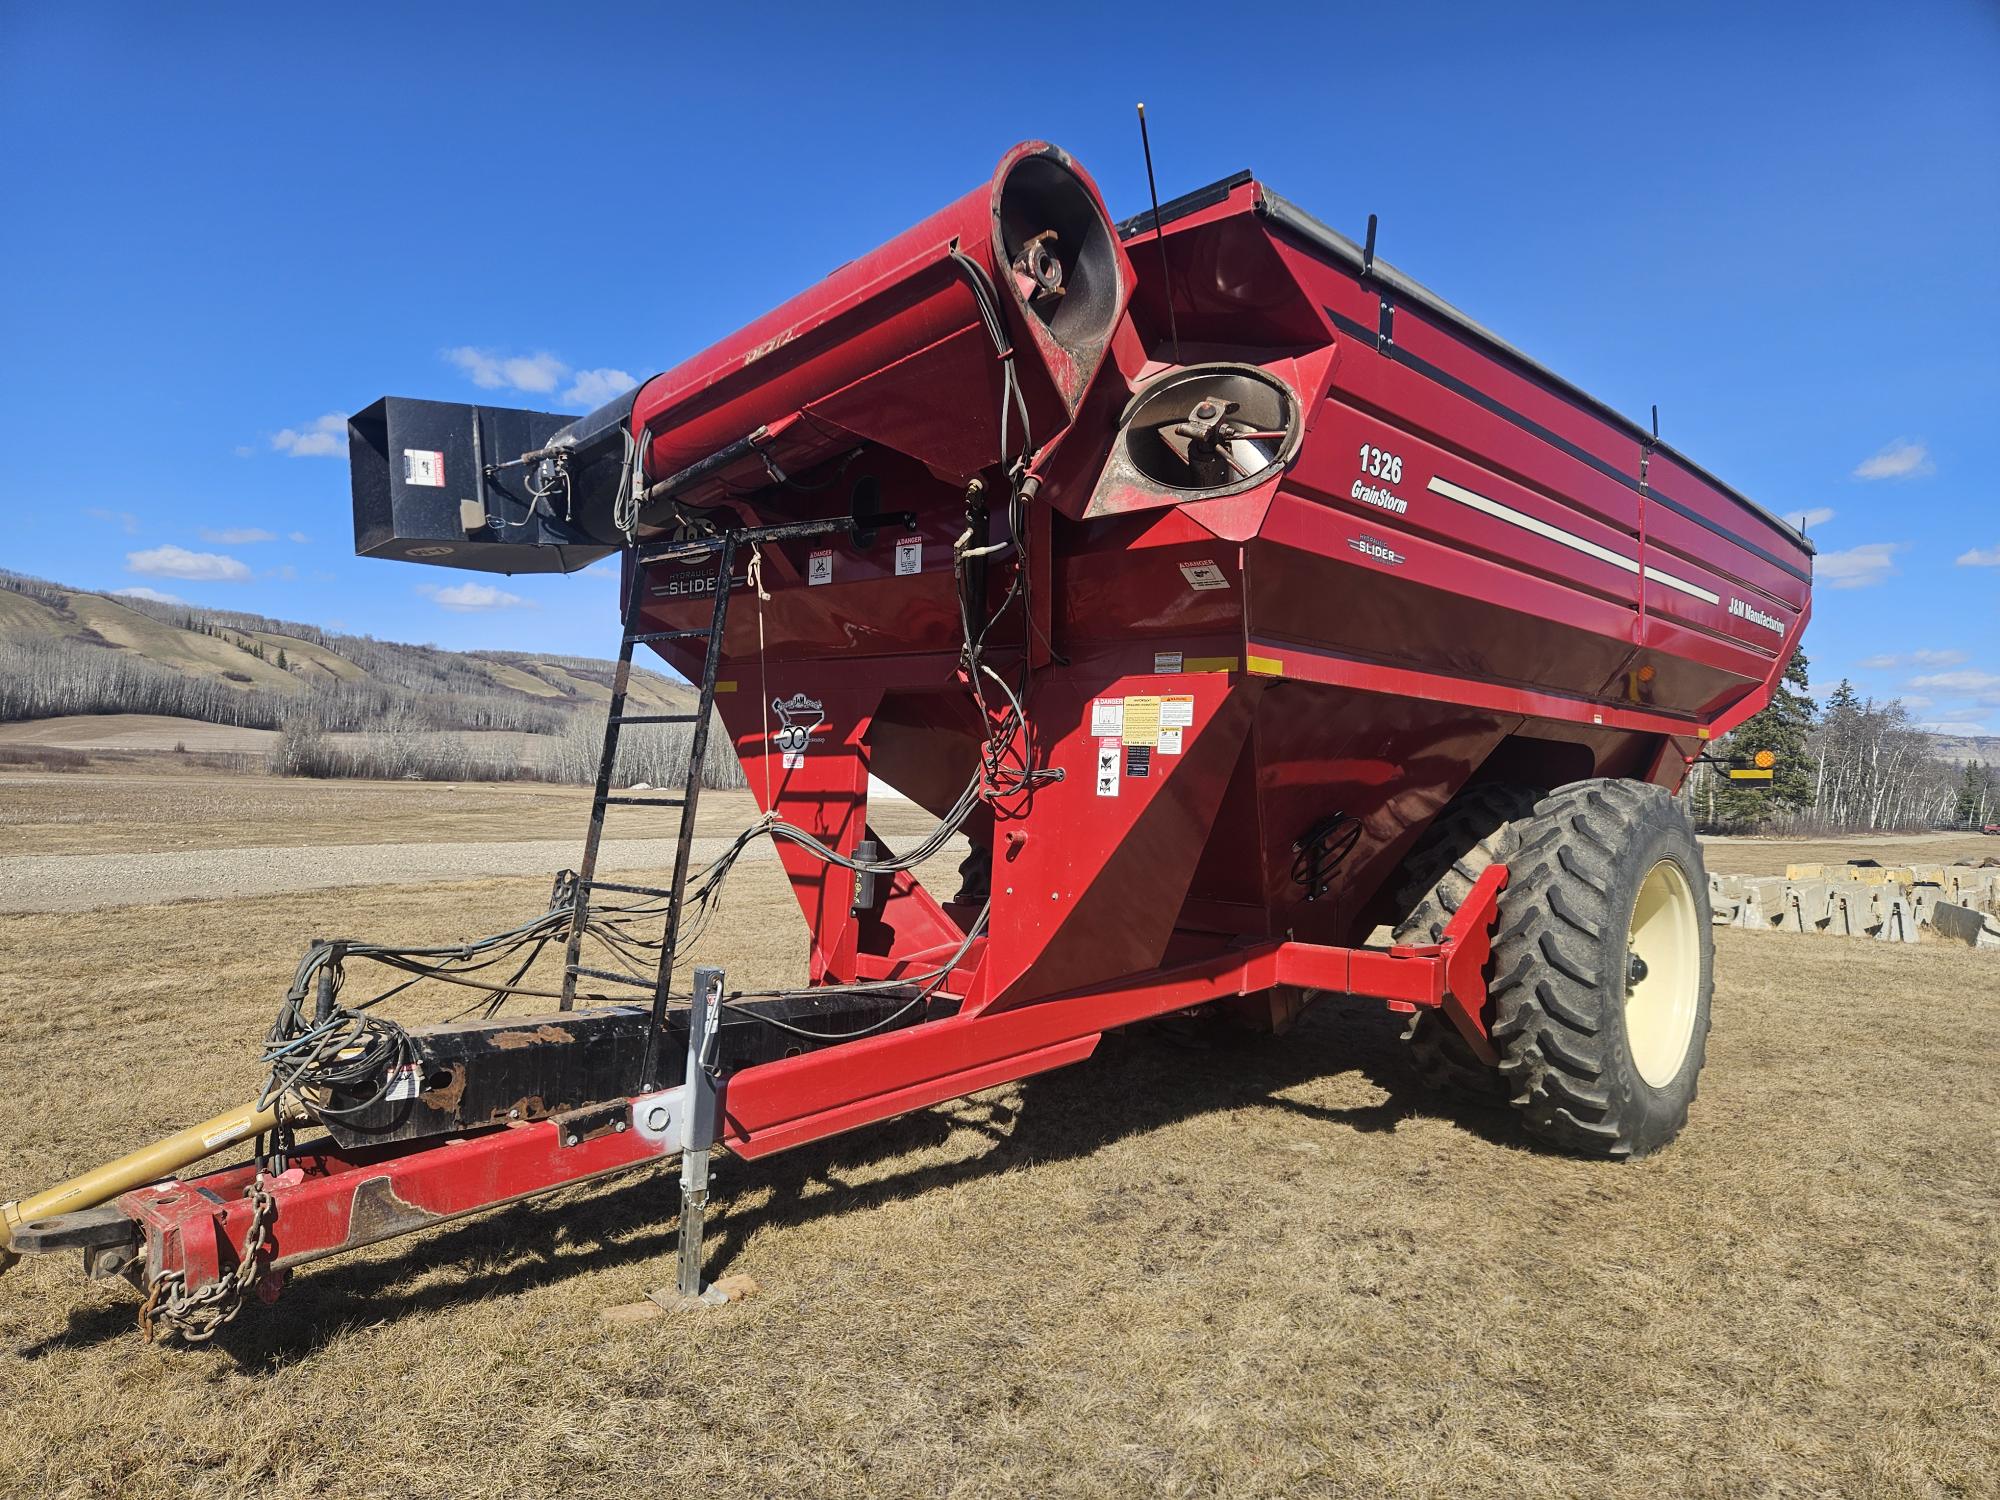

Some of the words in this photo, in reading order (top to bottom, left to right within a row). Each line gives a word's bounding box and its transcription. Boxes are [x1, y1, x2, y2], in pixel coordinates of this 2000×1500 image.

[1359, 443, 1403, 484] 1326
[1351, 479, 1408, 514] GrainStorm
[901, 537, 922, 546] DANGER
[1359, 541, 1395, 562] SLIDER
[812, 550, 832, 559] DANGER
[1184, 560, 1215, 568] DANGER
[669, 577, 718, 595] SLIDE
[1728, 597, 1745, 617] J&M
[1744, 603, 1785, 638] Manufacturing
[781, 725, 807, 750] 50
